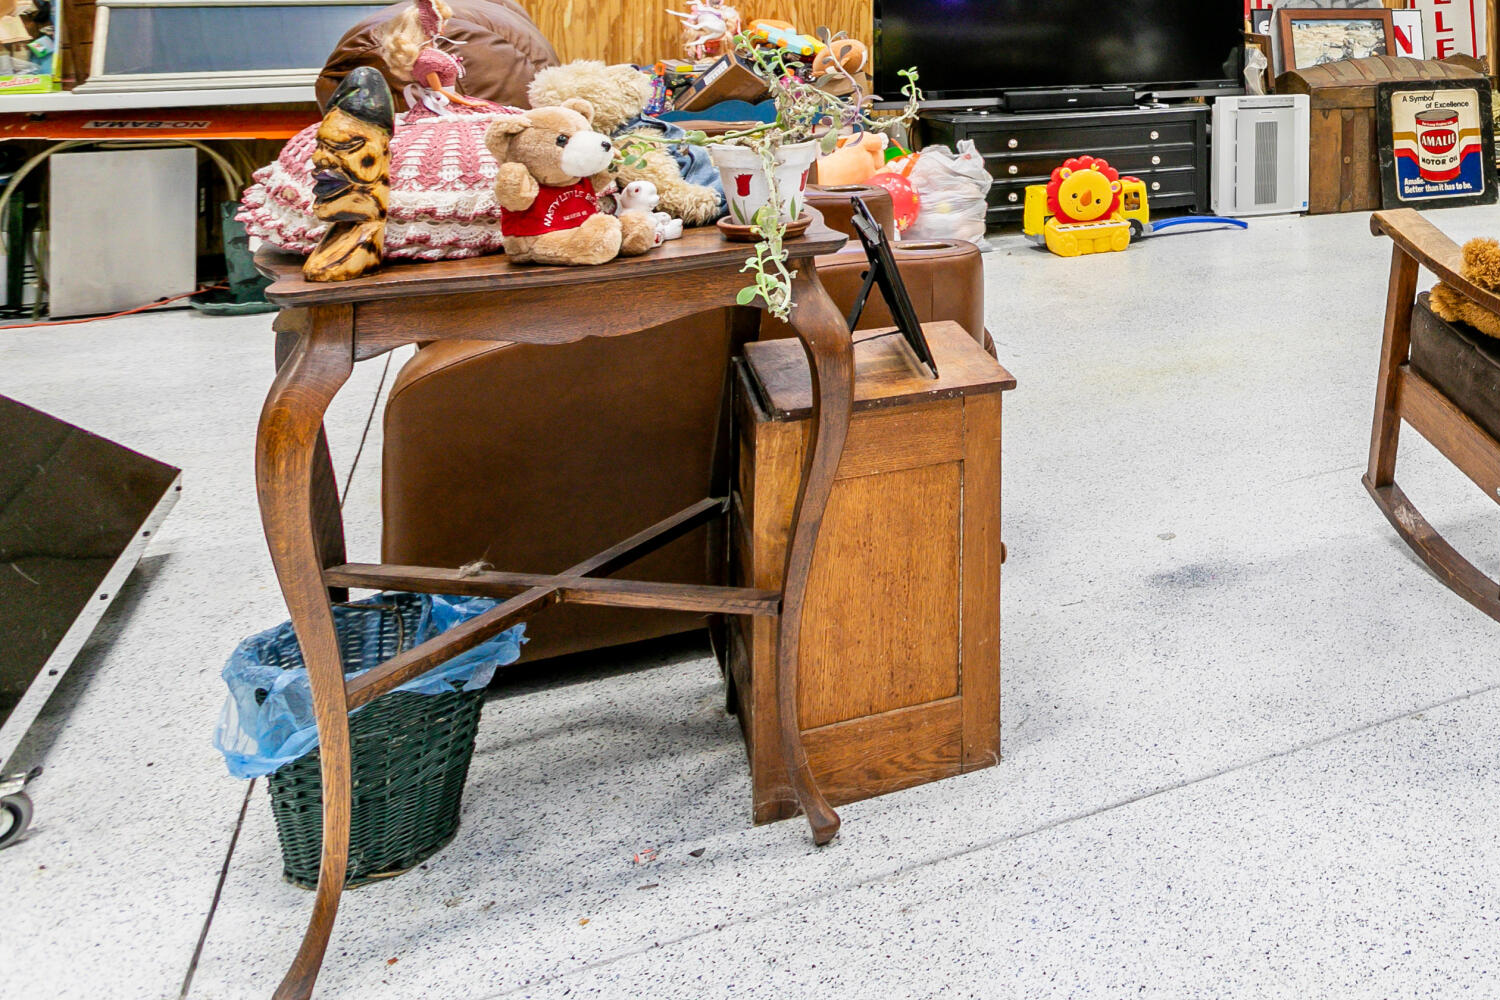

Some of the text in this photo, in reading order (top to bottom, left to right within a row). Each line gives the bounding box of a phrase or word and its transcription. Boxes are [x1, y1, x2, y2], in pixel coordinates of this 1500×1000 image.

[1409, 95, 1434, 104] Symbol
[1434, 101, 1469, 109] Excellence
[94, 121, 209, 129] NO-BAMA
[1421, 133, 1456, 147] AMALIE
[1421, 157, 1446, 166] MOTOR
[1404, 178, 1426, 186] Amalie.
[1404, 184, 1425, 194] Better
[1425, 184, 1439, 192] than
[1439, 183, 1445, 191] it
[1445, 183, 1455, 191] has
[1456, 182, 1463, 190] to
[543, 197, 560, 227] NASTY
[558, 189, 585, 202] LITTLE
